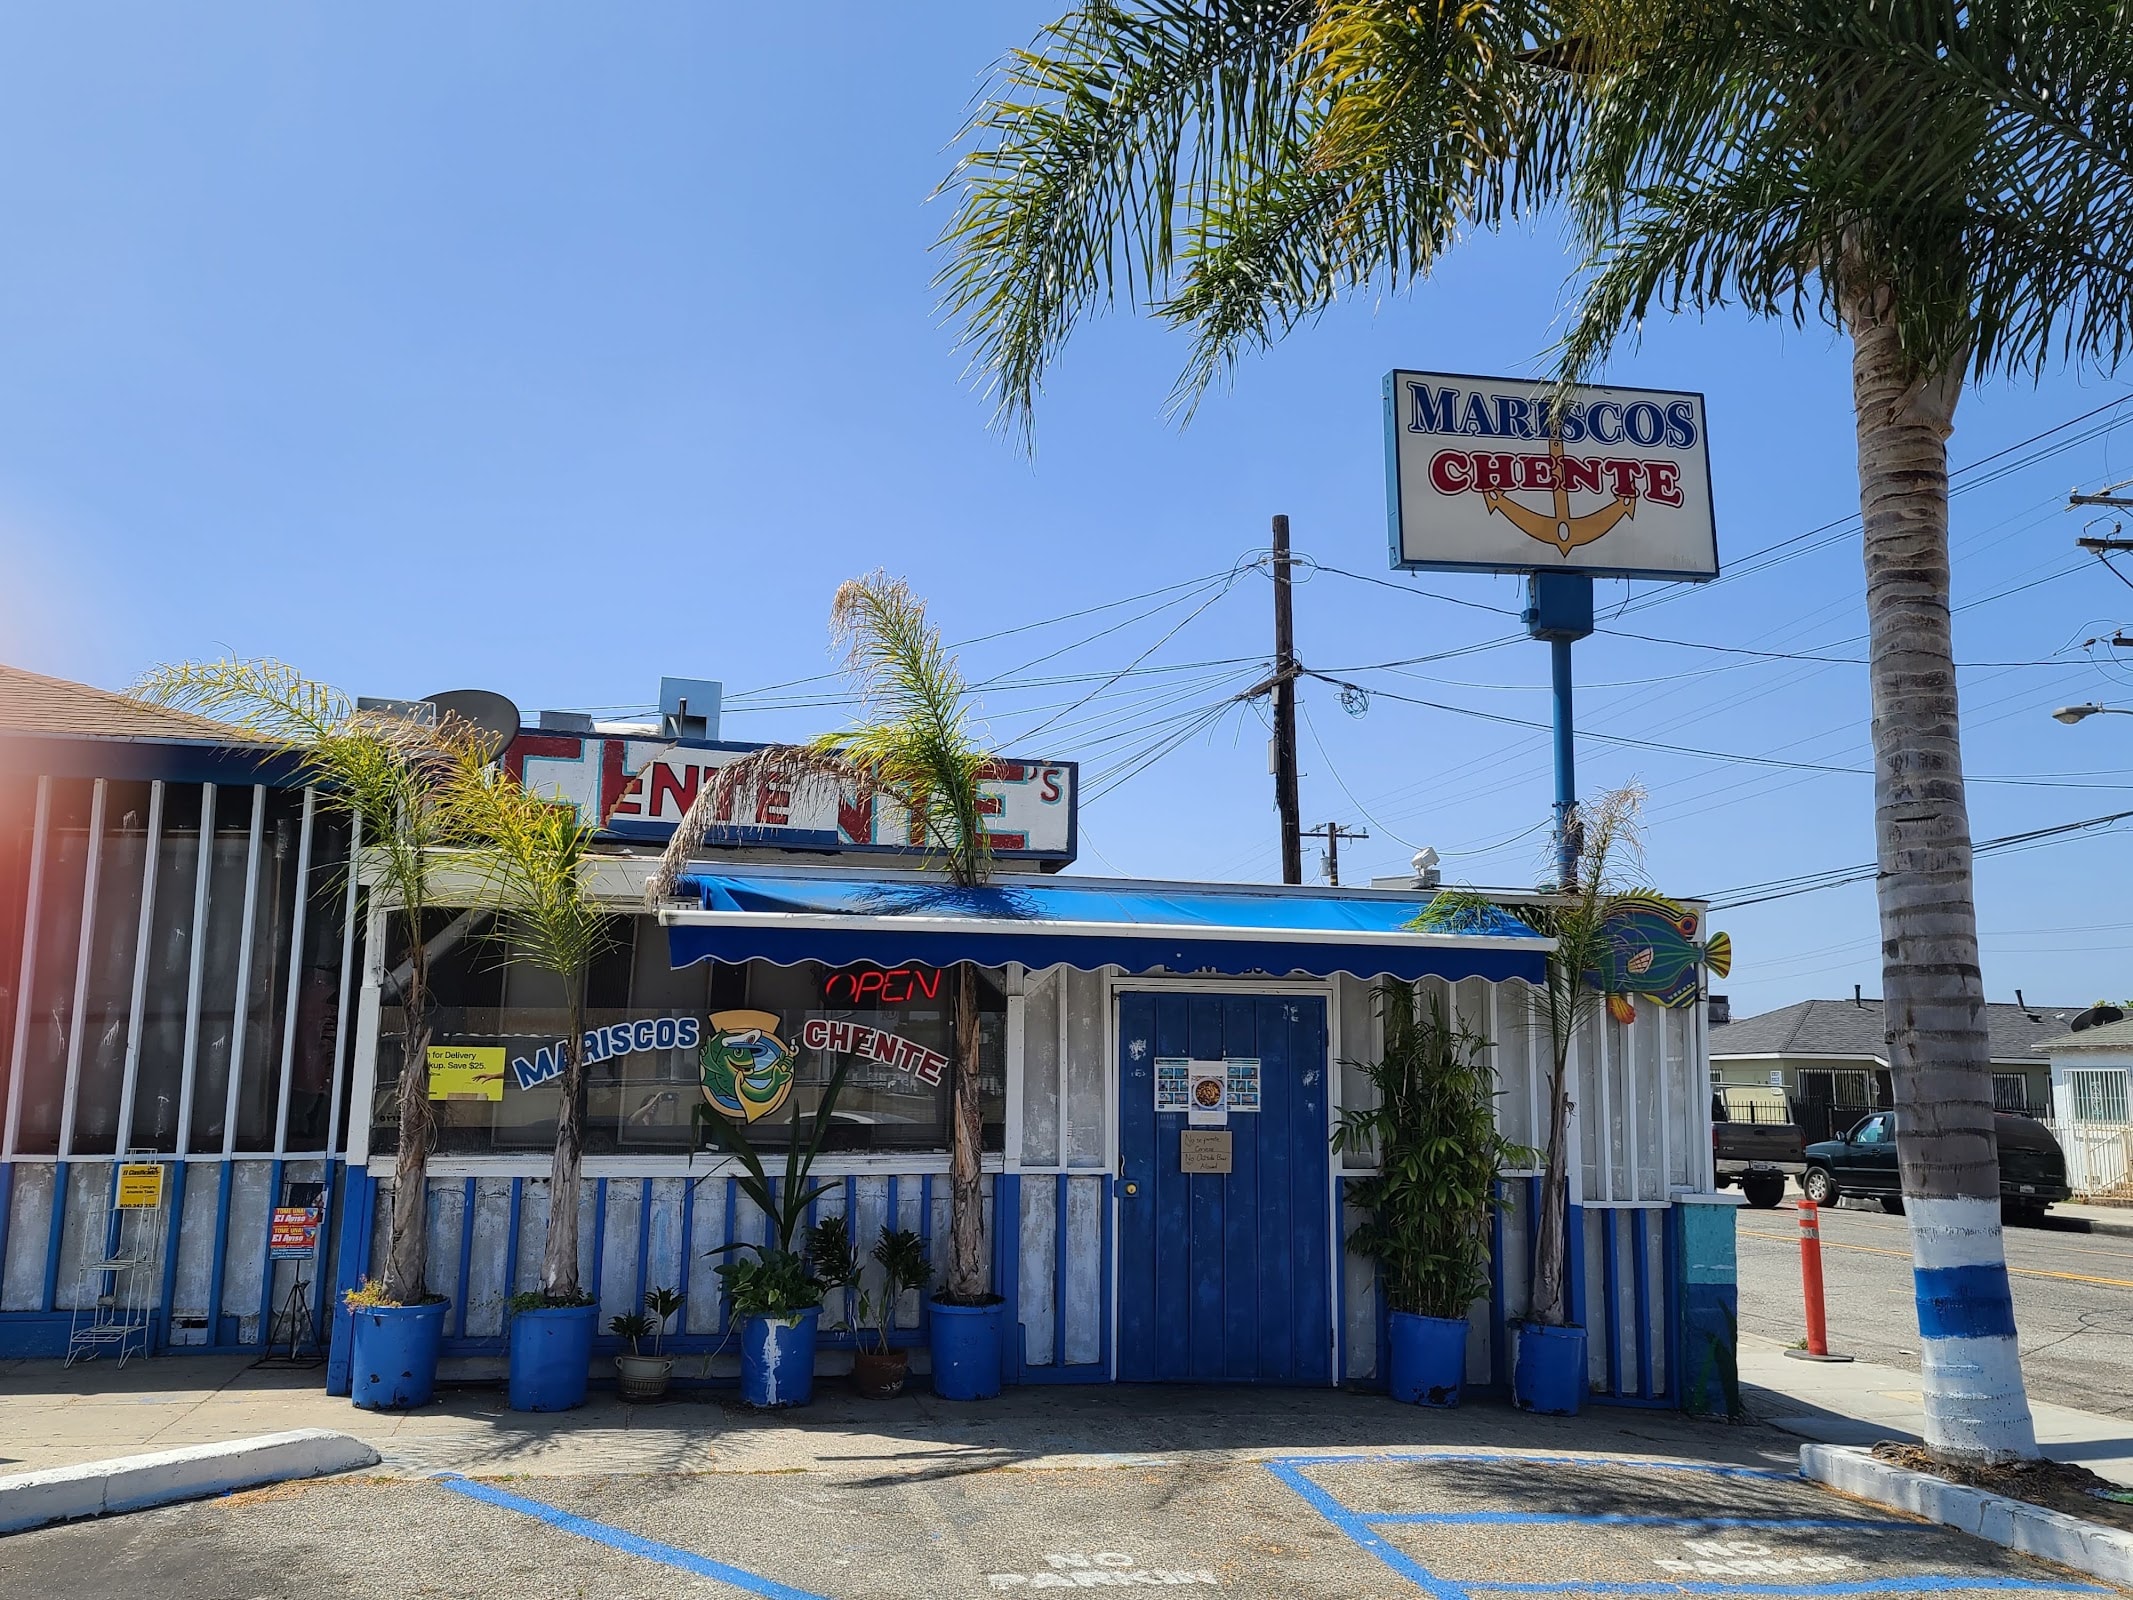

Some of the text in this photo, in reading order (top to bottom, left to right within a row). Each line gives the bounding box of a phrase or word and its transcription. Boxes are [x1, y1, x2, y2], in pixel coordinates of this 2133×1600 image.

[1407, 381, 1698, 449] MARISCOS
[1428, 449, 1684, 509] CHENTE
[825, 968, 942, 1003] OPEN
[432, 1051, 443, 1059] for
[445, 1051, 477, 1060] Delivery
[803, 1019, 949, 1087] CHENTE
[448, 1062, 467, 1070] Save
[468, 1062, 486, 1070] $25.
[271, 1234, 282, 1242] El
[1683, 1541, 1772, 1558] NO
[1045, 1552, 1133, 1569] NO
